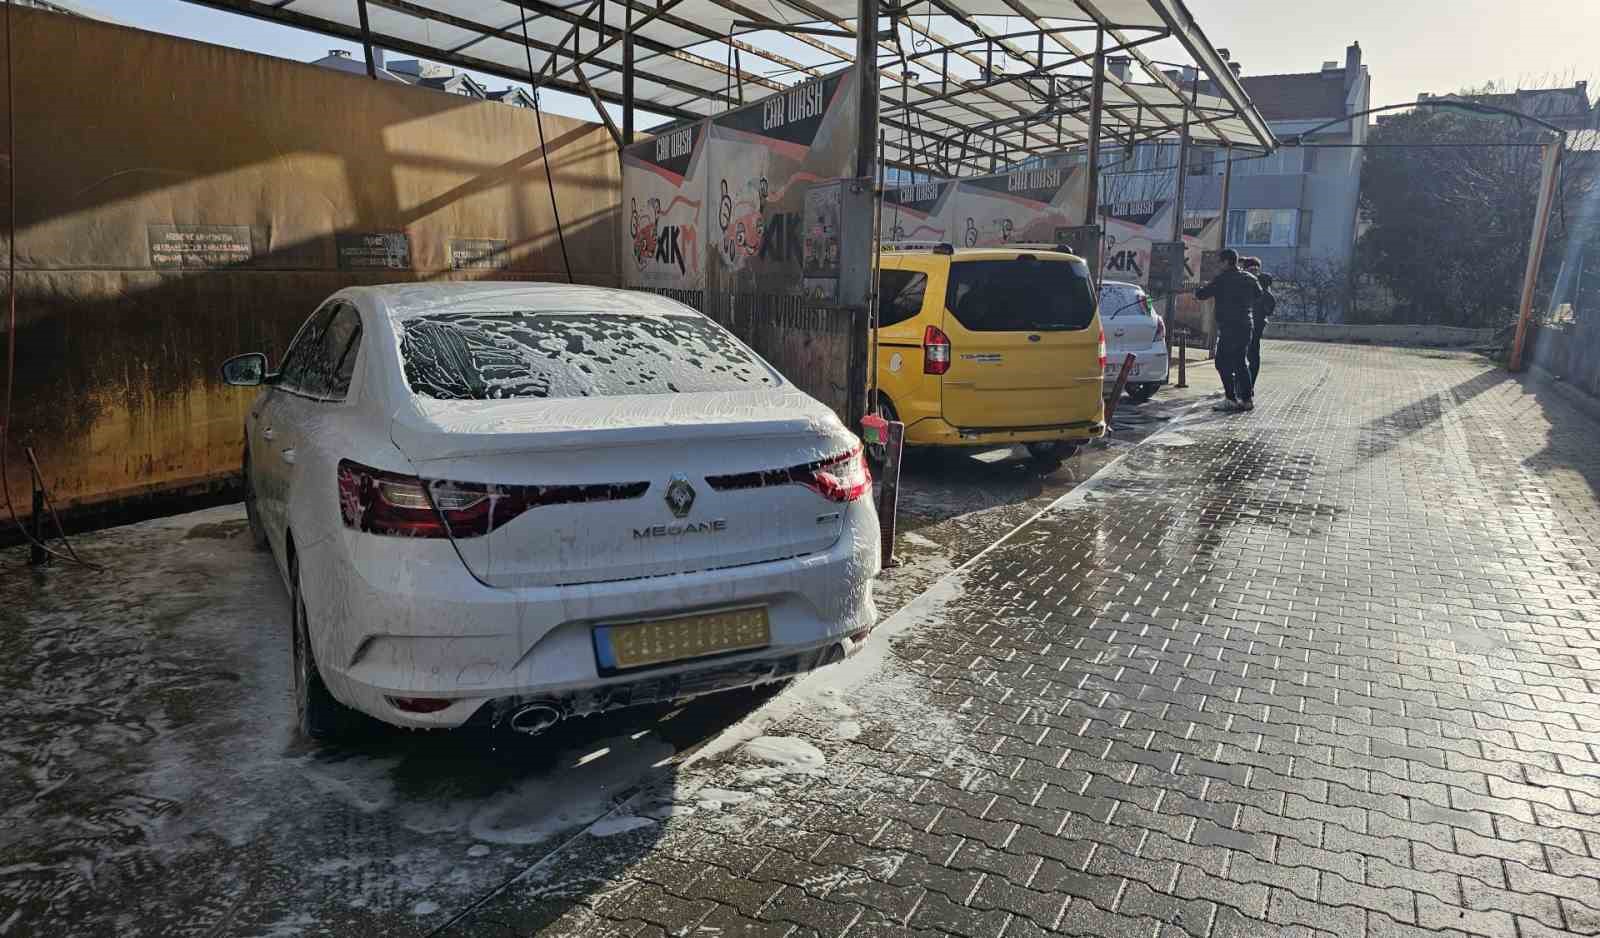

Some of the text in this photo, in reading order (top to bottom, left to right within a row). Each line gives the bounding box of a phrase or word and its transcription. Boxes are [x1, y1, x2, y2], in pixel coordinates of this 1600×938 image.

[763, 80, 823, 130] CAR WASH
[656, 127, 692, 161] CAR WASH
[1008, 168, 1060, 192] CAR WASH
[900, 182, 937, 202] CAR WASH
[1112, 199, 1154, 216] CAR WASH
[633, 519, 727, 540] MEGANE
